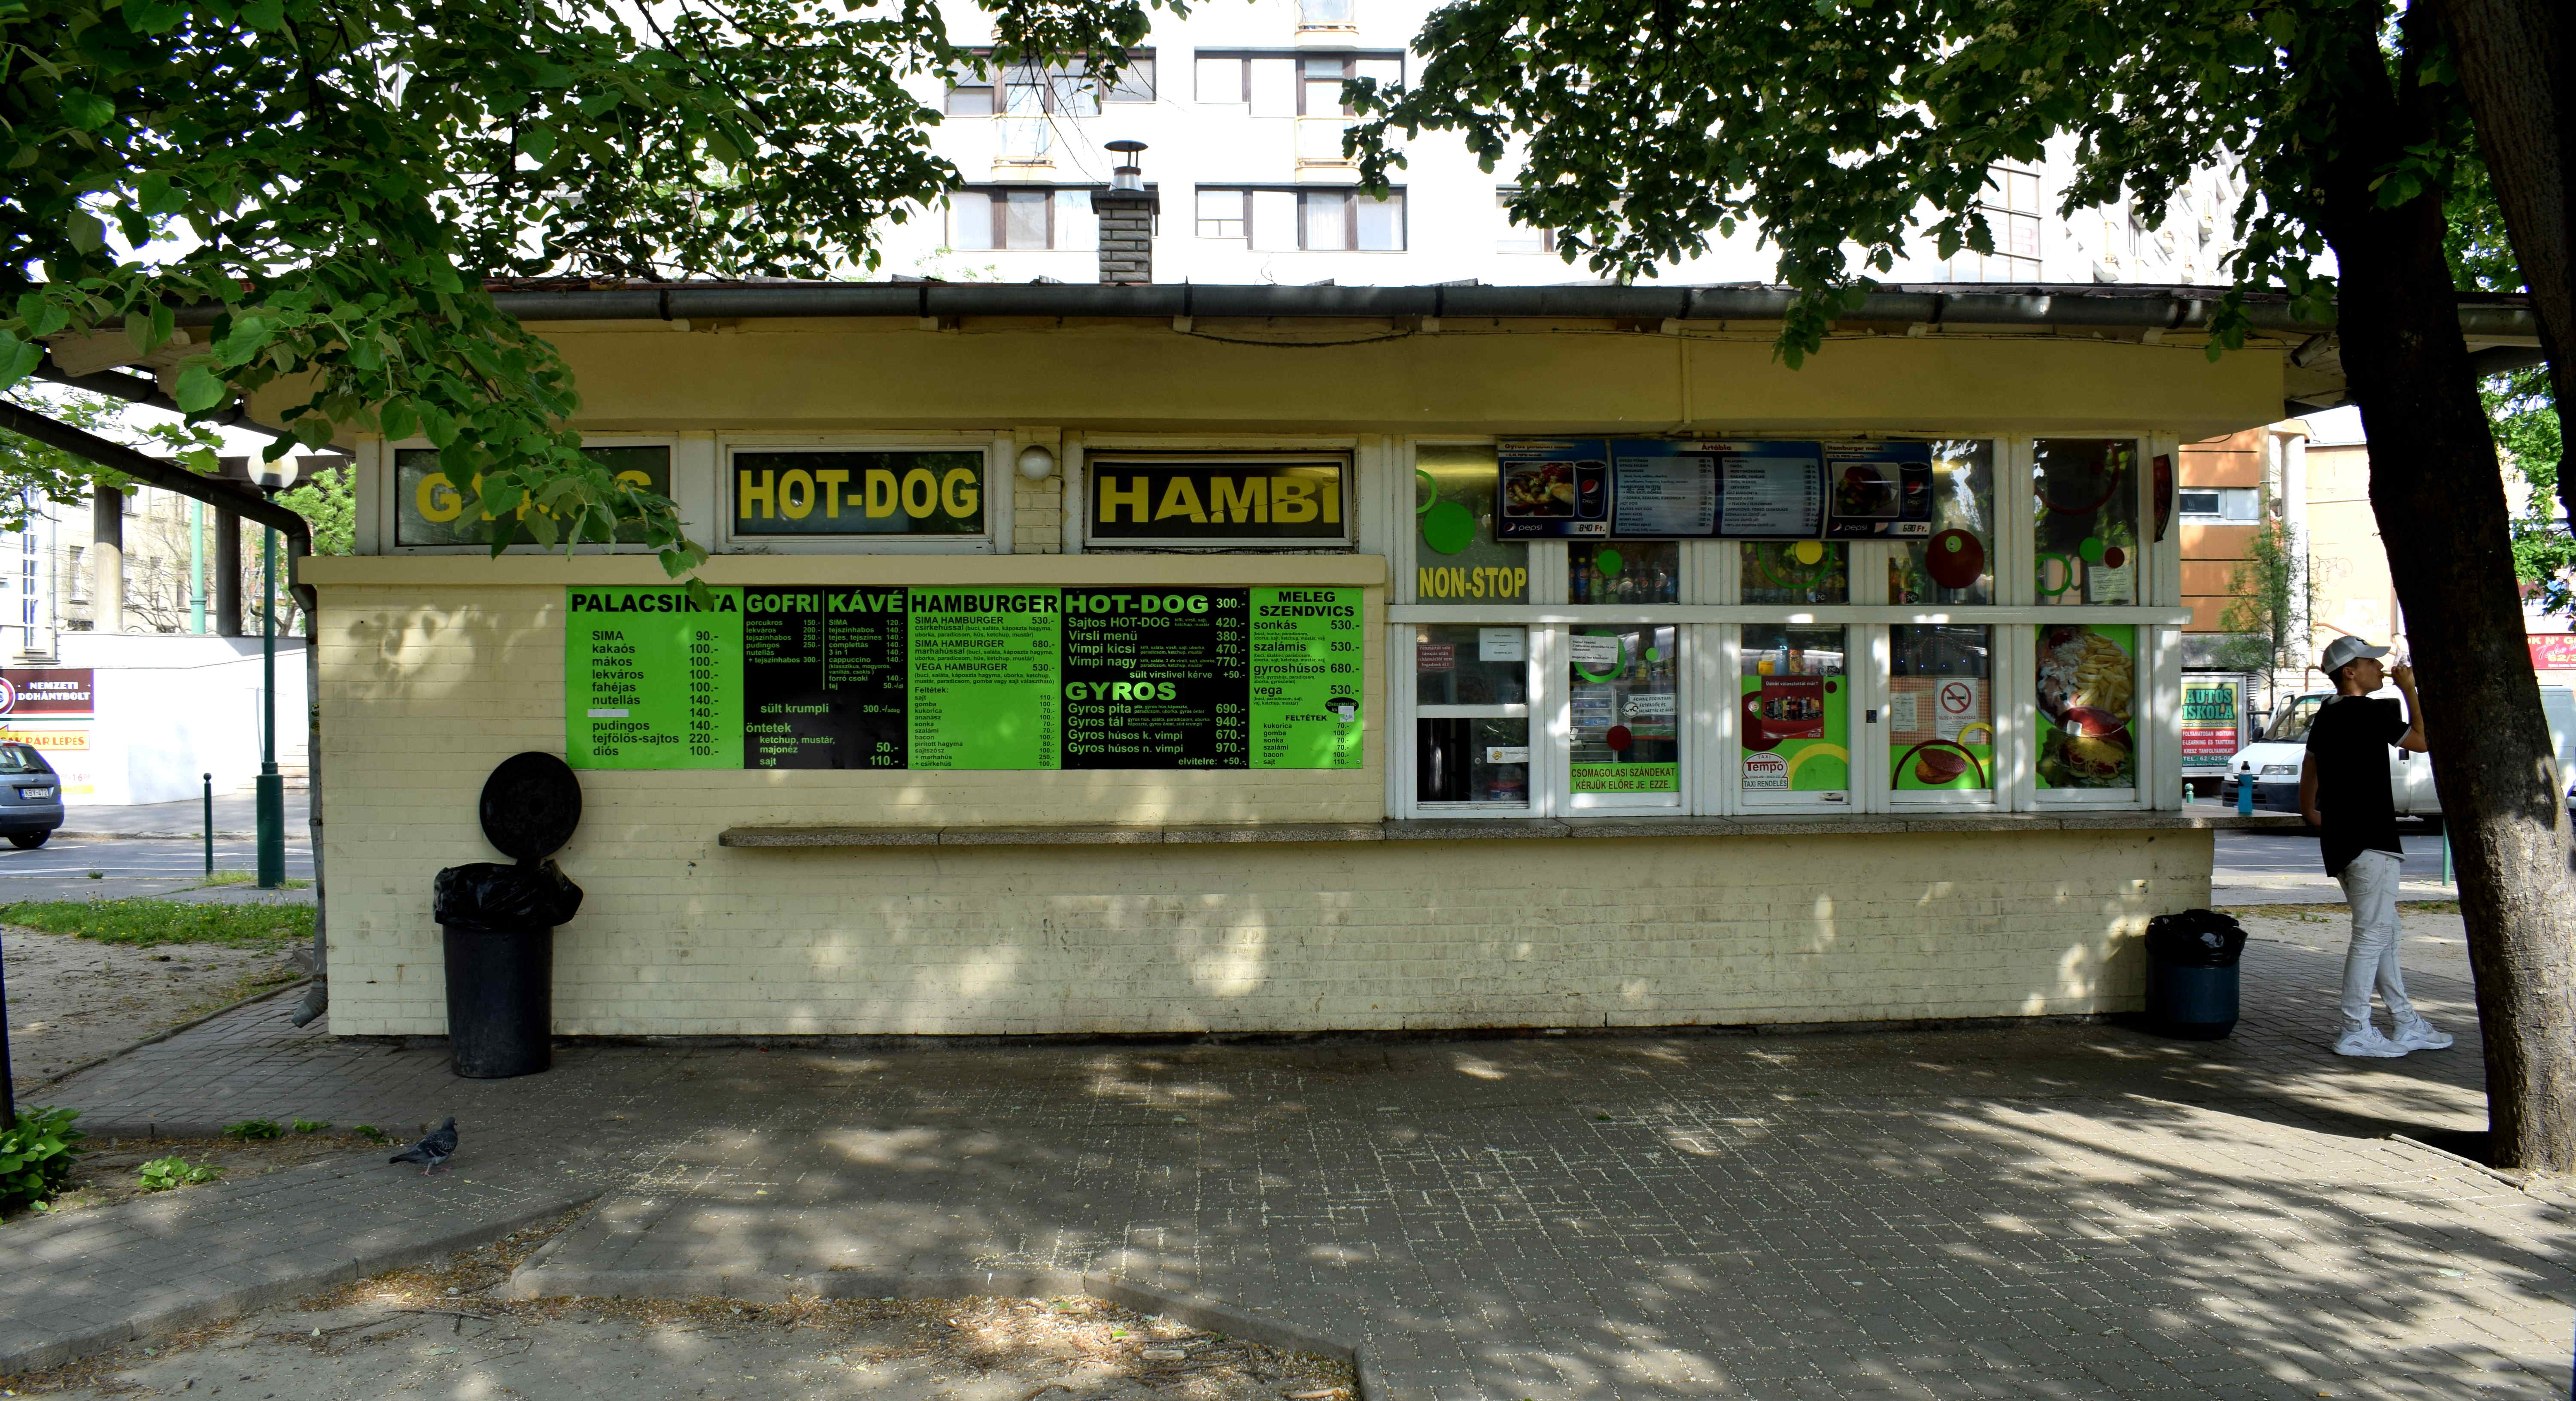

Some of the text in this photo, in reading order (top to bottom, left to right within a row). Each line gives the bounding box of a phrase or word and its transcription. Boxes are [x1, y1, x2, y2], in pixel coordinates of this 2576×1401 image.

[739, 468, 978, 519] HOT-DOG
[1100, 476, 1340, 524] HAMBI
[1518, 524, 1542, 532] pepsi
[1419, 567, 1526, 598] NON-STOP
[828, 590, 903, 613] KÁVÉ
[1279, 591, 1336, 603] MELEG
[747, 594, 818, 613] GOFRI
[911, 595, 1058, 613] HAMBURGER
[1066, 595, 1245, 613] HOT-DOG 300.-
[1260, 605, 1354, 617] SZENDVICS
[1068, 617, 1245, 629] Sajtos HOT-DOG 420.-
[1254, 620, 1359, 630] sonkás 530.-
[592, 631, 718, 640] SIMA 90.-
[1069, 631, 1245, 641] Virsli menü 380.-
[592, 644, 718, 653] kakaós 100.-
[1254, 642, 1359, 652] szalámis 530.-
[592, 657, 718, 666] mákos 100.-
[592, 670, 718, 679] lekváros 100.-
[1254, 664, 1359, 676] gyroshúsos 680.-
[592, 682, 718, 694] fahéjas 100.-
[1066, 682, 1176, 700] GYROS
[1254, 685, 1359, 697] vega 530.-
[18, 691, 91, 700] DOHÁNYBOLT
[2184, 684, 2233, 704] AUTÓS
[592, 695, 718, 705] nutellás 140.-
[690, 708, 718, 718] 140.-
[760, 704, 782, 713] sült
[786, 704, 829, 715] krumpli
[1068, 704, 1245, 715] Gyros pita 690.-
[2182, 705, 2235, 719] ISKOLA
[593, 721, 718, 732] pudingos 140.-
[746, 722, 791, 733] öntetek
[1068, 716, 1245, 728] Gyros tál 940.-
[25, 735, 49, 745] PÁR
[53, 736, 85, 745] LÉPÉS
[593, 734, 718, 745] tejfölös-sajtos 220.-
[759, 736, 835, 745] ketchup, mustár,
[593, 746, 718, 756] diós 100.-
[759, 742, 899, 754] majonéz 50.-
[759, 756, 899, 766] sajt 110.-
[1746, 761, 1783, 773] Tempó
[1576, 779, 1606, 789] KÉRJÜK
